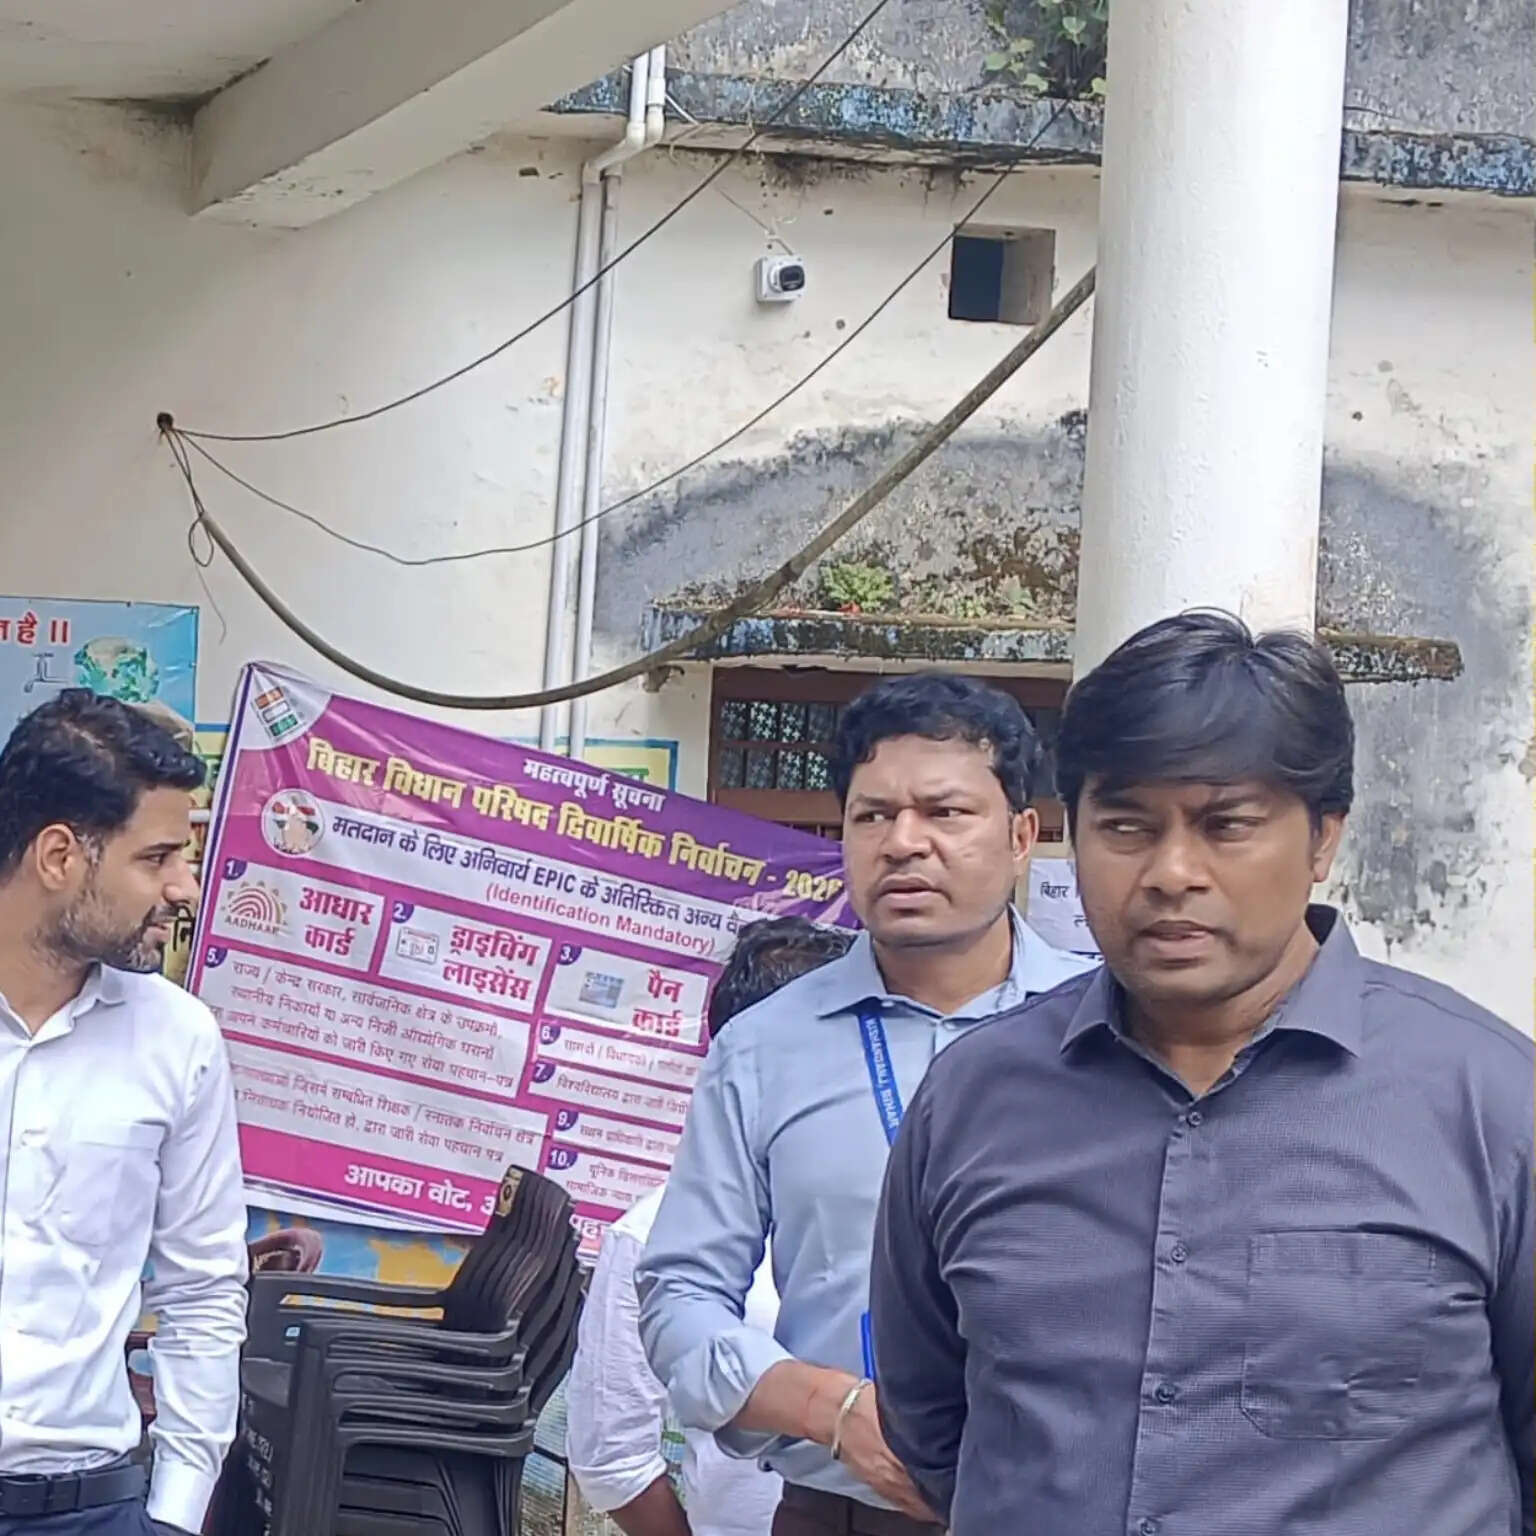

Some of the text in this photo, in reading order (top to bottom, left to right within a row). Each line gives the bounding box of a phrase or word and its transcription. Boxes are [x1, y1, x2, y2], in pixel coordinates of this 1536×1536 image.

[17, 612, 39, 645] है
[524, 757, 609, 800] महत्वपूर्ण
[612, 780, 666, 812] सूचना
[307, 737, 381, 786] बिहार
[382, 756, 467, 809] विधान
[472, 783, 555, 831] परिषद
[669, 832, 767, 888] निर्वाचन
[332, 815, 395, 849] मतदान
[399, 826, 418, 853] के
[421, 835, 457, 865] लिए
[460, 847, 531, 884] अनिवार्य
[533, 866, 576, 895] EPIC
[580, 875, 600, 901] के
[684, 905, 722, 931] अन्य
[299, 886, 375, 926] आधार
[485, 882, 611, 930] (Identification
[616, 914, 717, 956] Mandatory)
[304, 924, 356, 957] कार्ड
[449, 924, 541, 967] ड्राइविंग
[442, 958, 532, 1001] लाइसेंस
[646, 968, 684, 1004] पैन
[632, 1006, 683, 1037] कार्ड
[344, 1162, 423, 1202] आपका
[426, 1175, 473, 1214] वोट,
